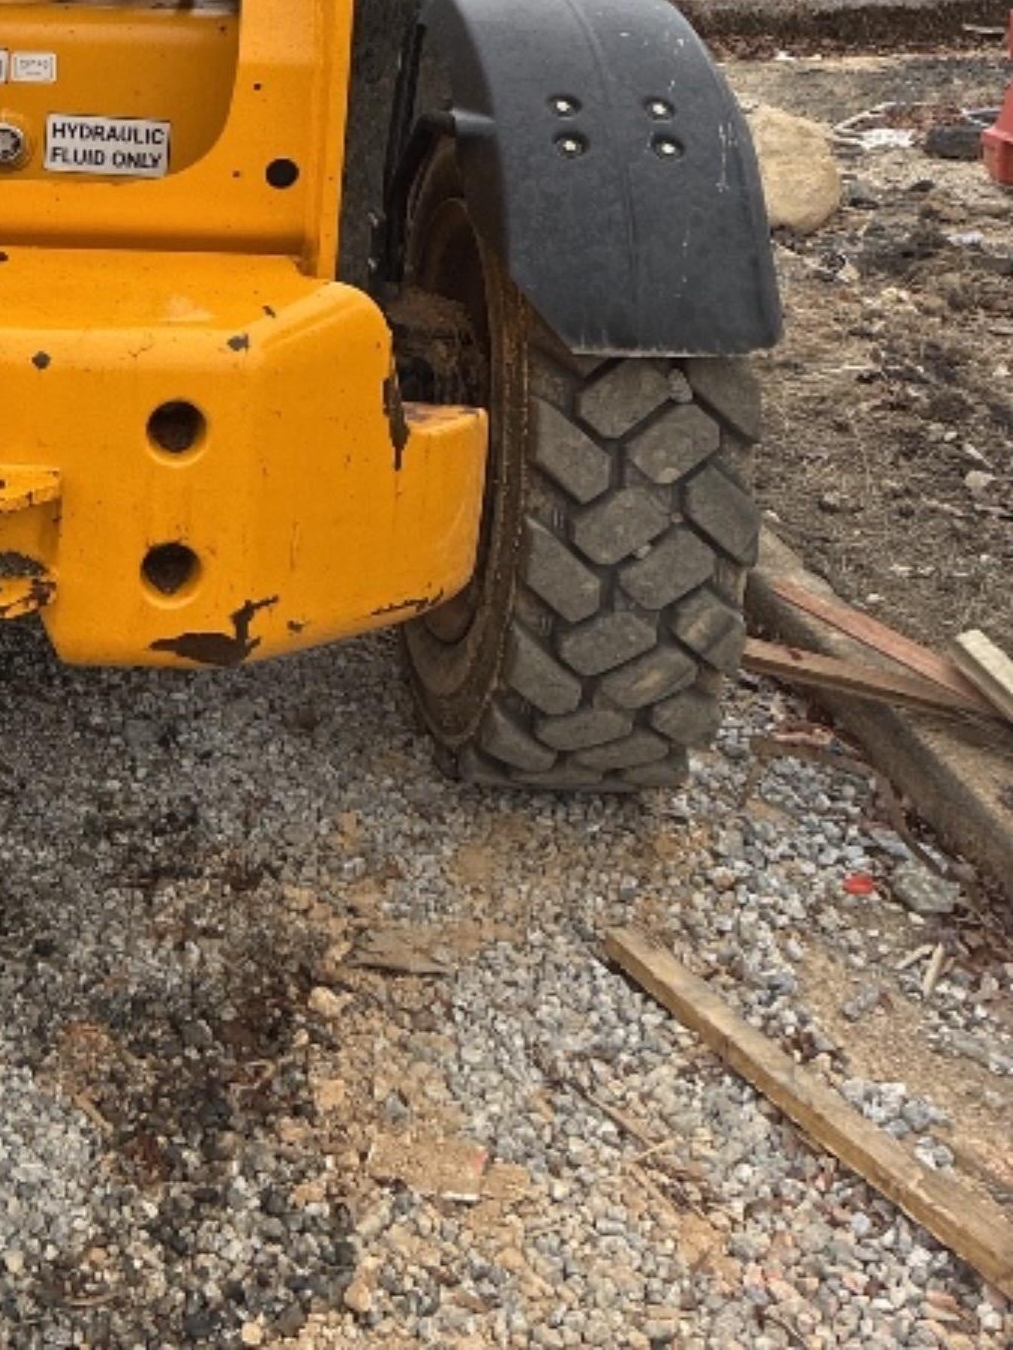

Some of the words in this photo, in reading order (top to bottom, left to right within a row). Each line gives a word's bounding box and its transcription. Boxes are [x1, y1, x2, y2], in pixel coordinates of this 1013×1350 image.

[51, 122, 165, 145] HYDRAULIC
[50, 146, 105, 166] FLUID
[111, 151, 162, 169] ONLY
